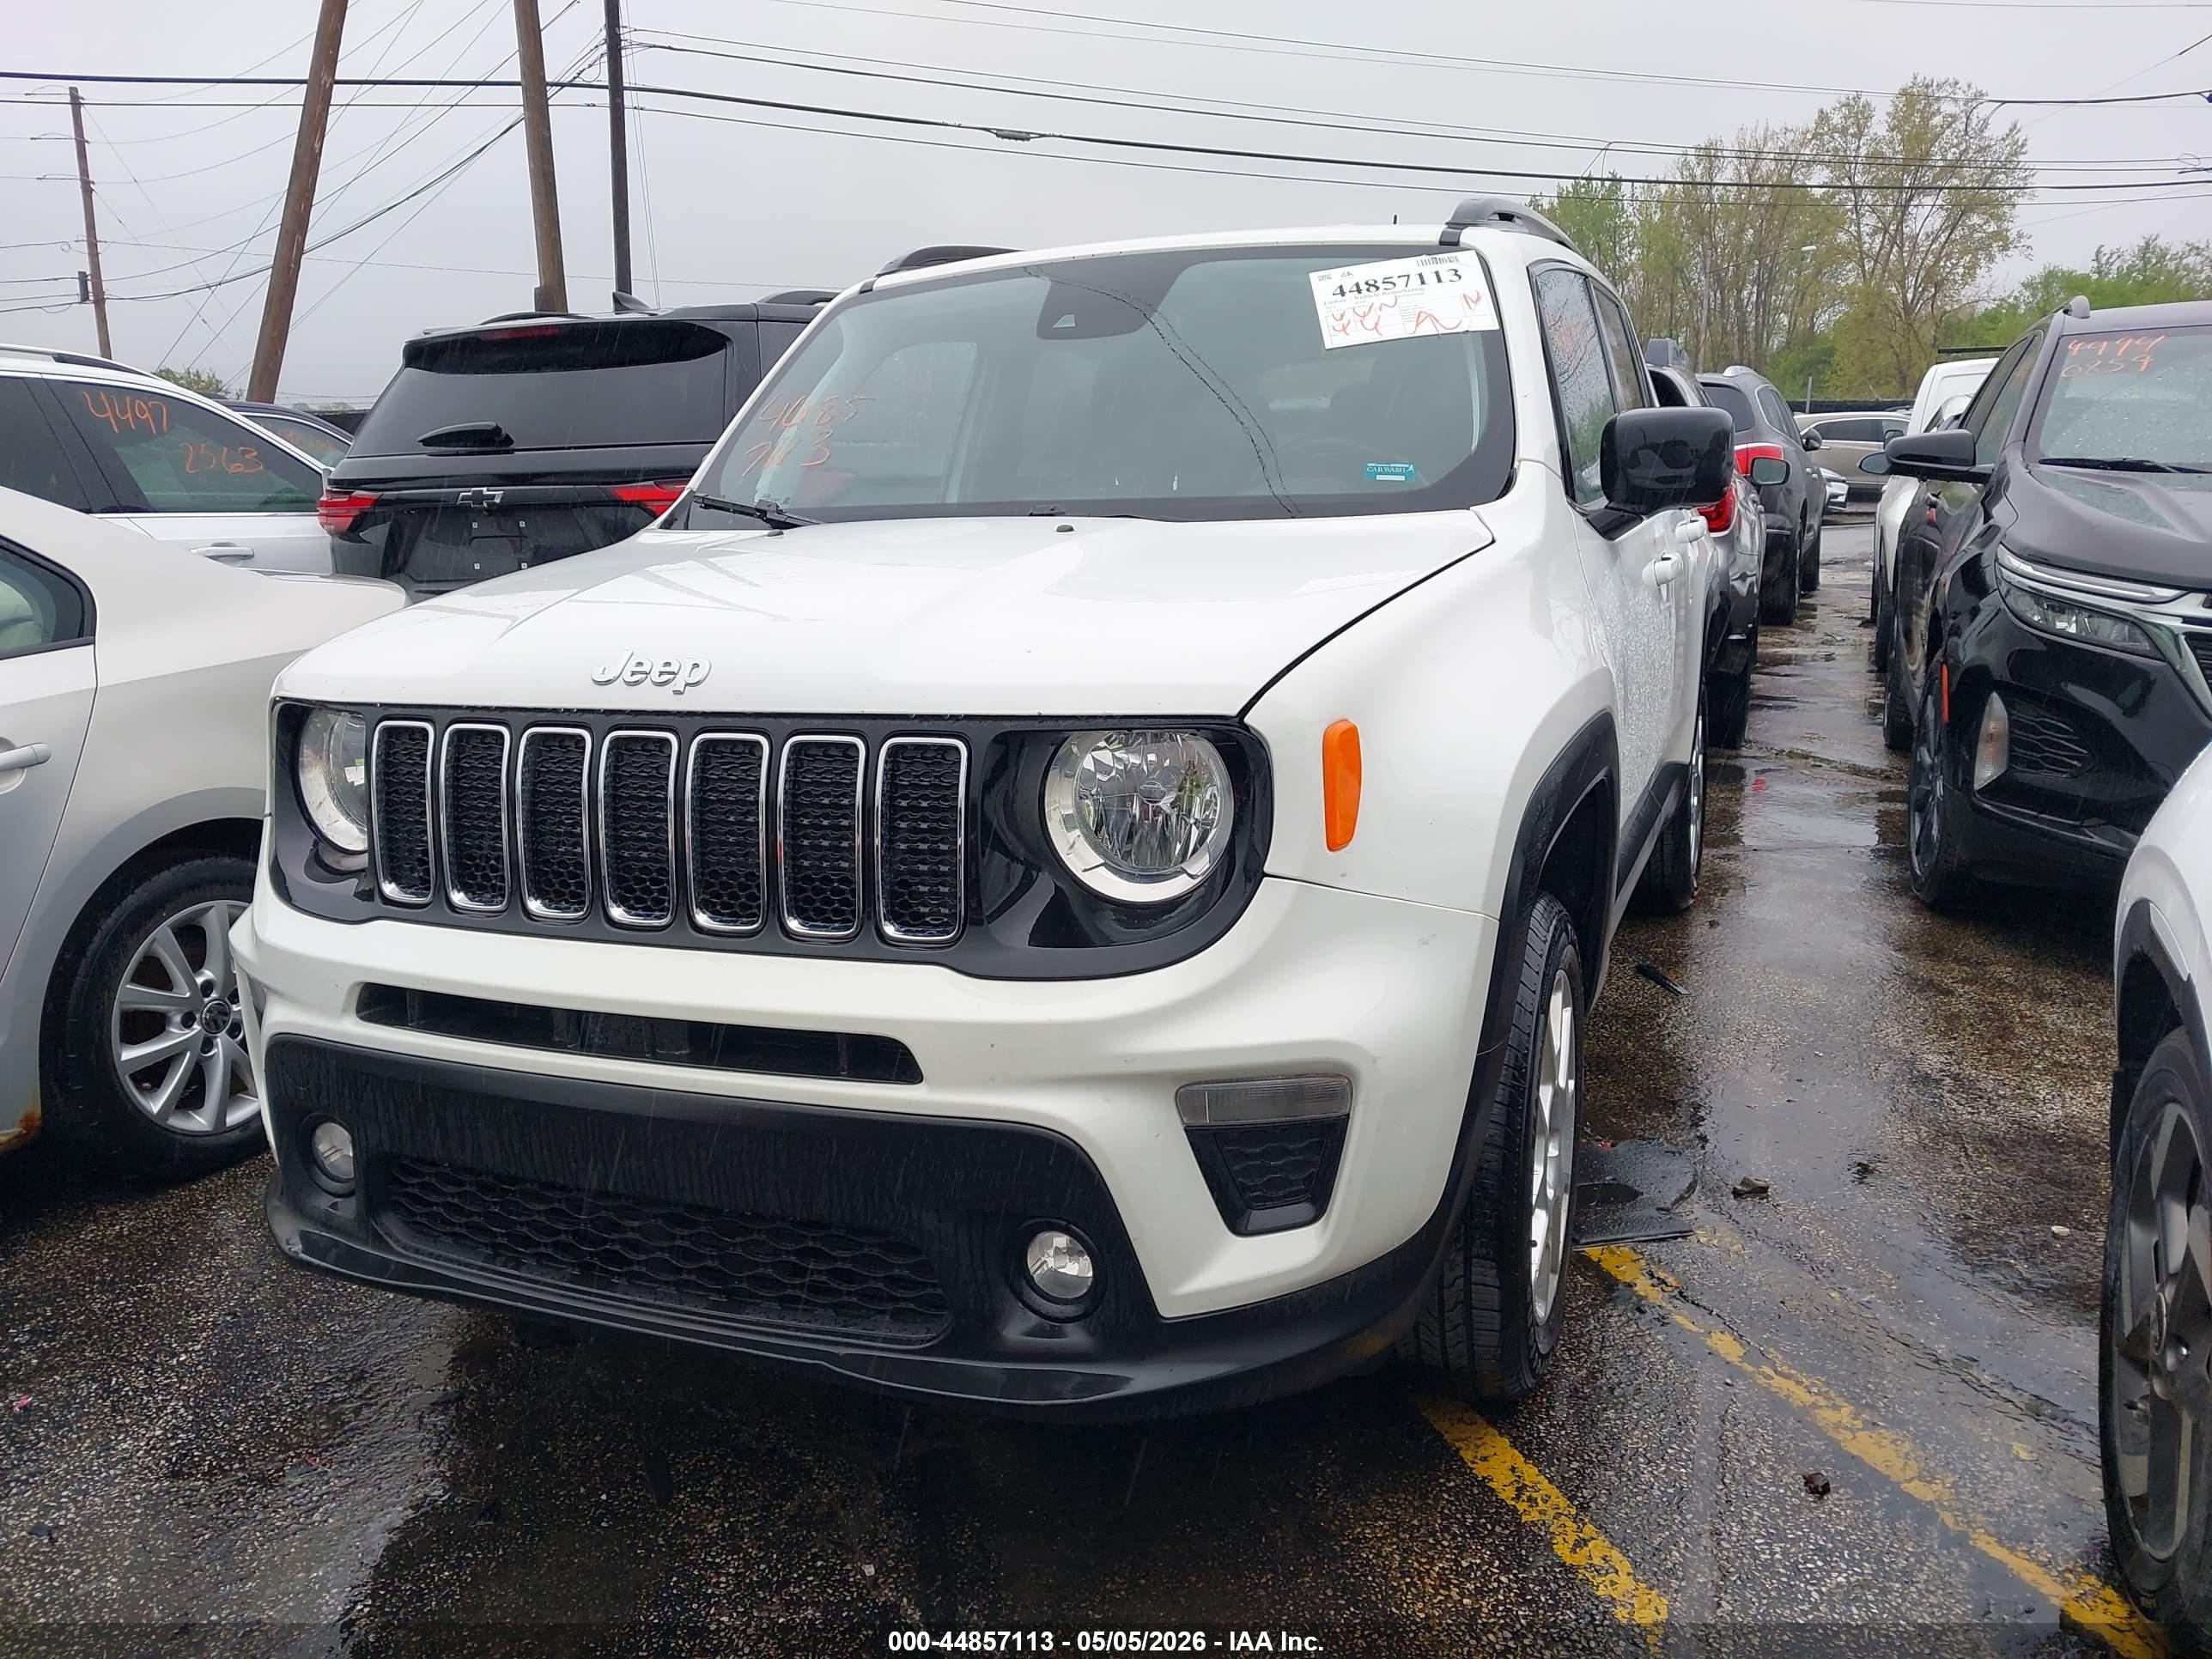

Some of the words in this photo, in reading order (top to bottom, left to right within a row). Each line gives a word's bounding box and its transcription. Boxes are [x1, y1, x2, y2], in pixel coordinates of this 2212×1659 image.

[1332, 268, 1462, 298] 44857113
[82, 391, 169, 434] 4497
[591, 648, 712, 696] Jeep
